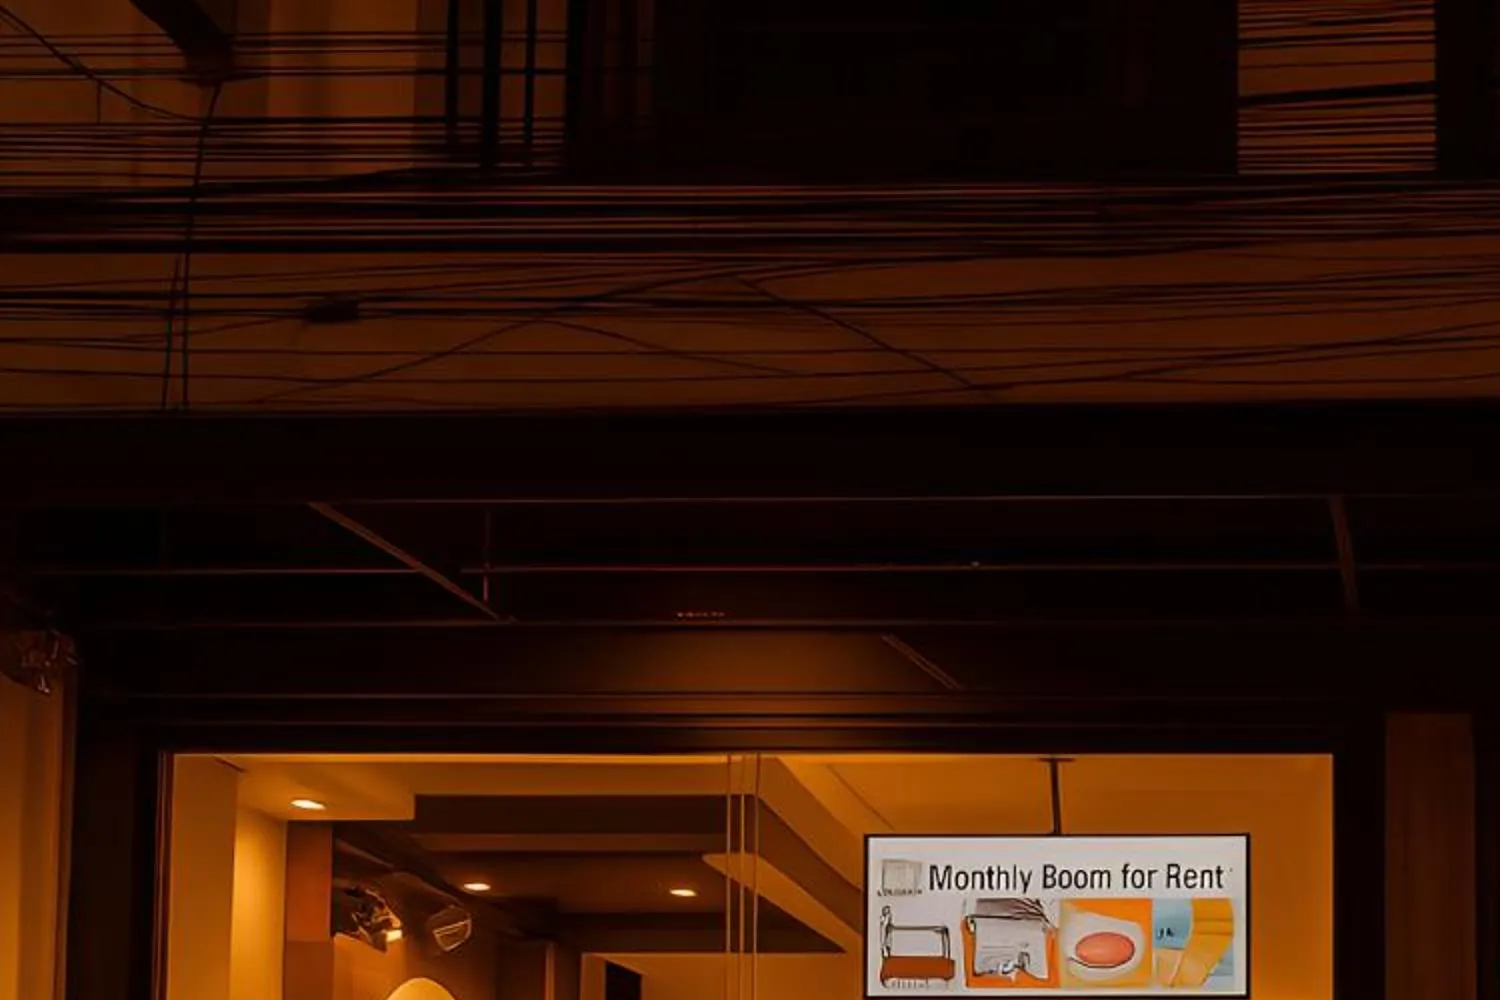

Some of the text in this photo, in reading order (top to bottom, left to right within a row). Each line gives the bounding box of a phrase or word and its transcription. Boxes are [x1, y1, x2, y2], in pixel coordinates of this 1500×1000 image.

[929, 864, 1033, 895] Monthly
[1042, 863, 1112, 890] Boom
[1121, 862, 1159, 889] for
[1165, 863, 1225, 890] Rent
